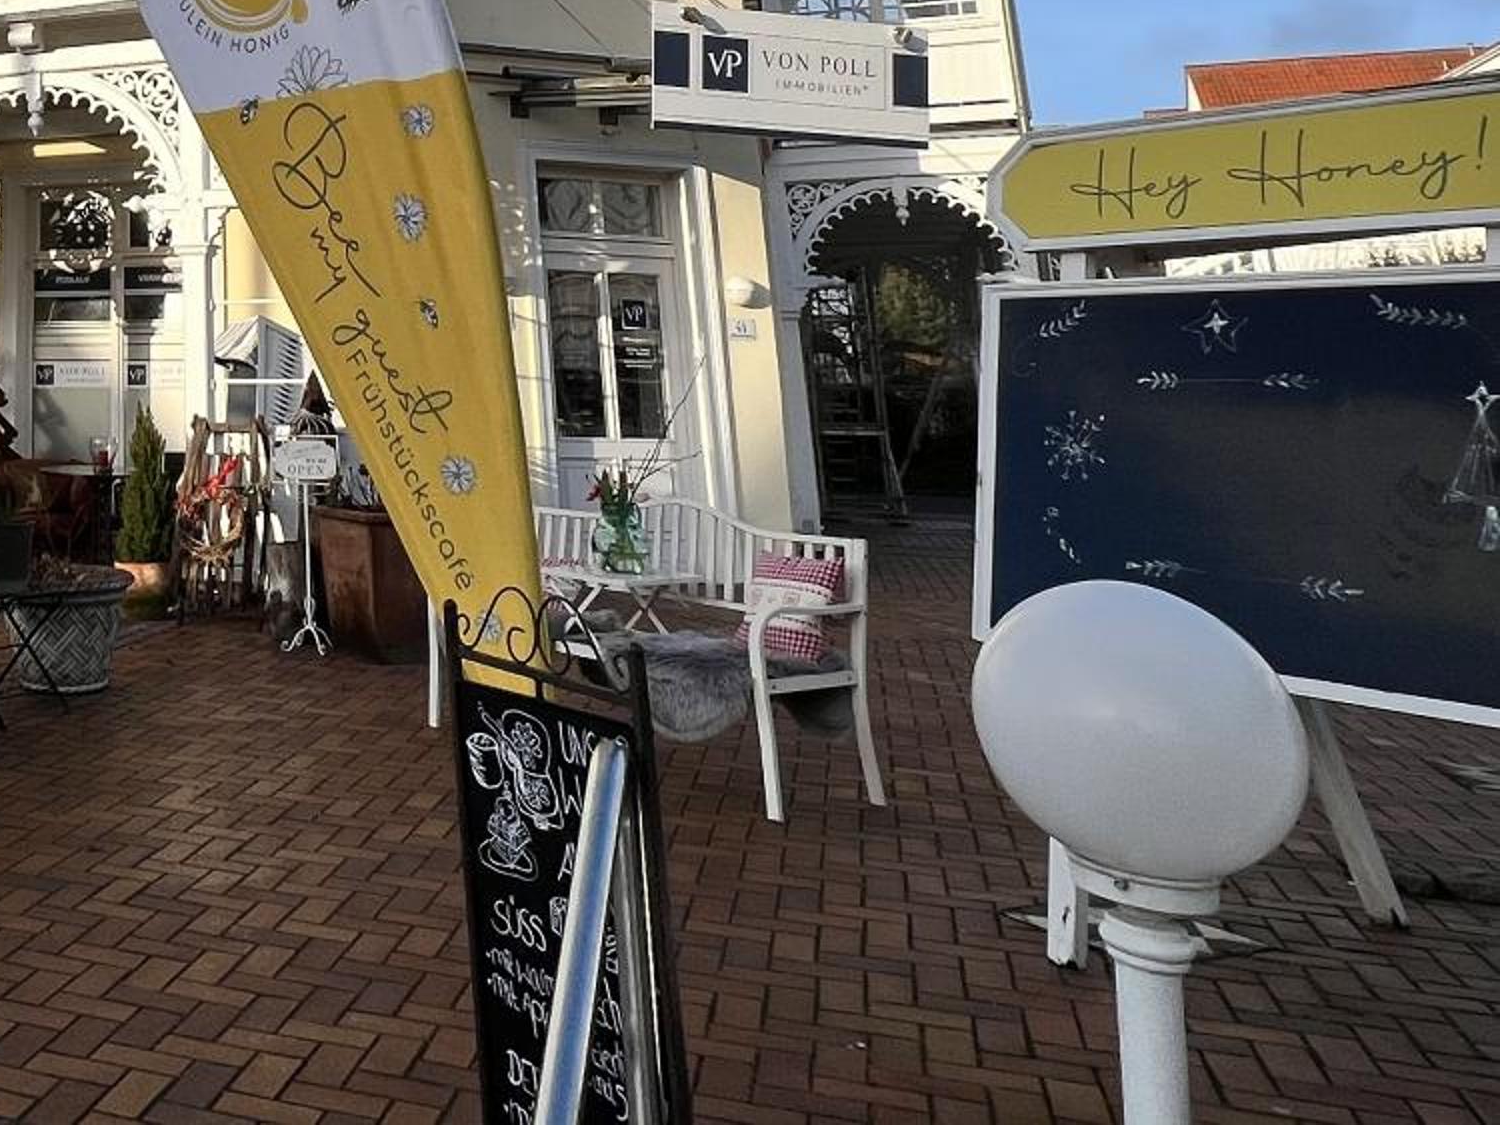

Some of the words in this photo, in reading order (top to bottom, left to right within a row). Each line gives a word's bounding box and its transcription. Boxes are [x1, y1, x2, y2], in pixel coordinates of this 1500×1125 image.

[229, 23, 290, 54] HONIG
[707, 49, 743, 77] VP
[762, 49, 811, 72] VON
[820, 56, 878, 78] POLL
[272, 102, 382, 299] Bee
[1070, 146, 1202, 220] Hey
[1227, 115, 1489, 207] Honey!
[310, 227, 347, 303] my
[331, 309, 453, 434] guest
[346, 348, 472, 592] Frühstückscafé
